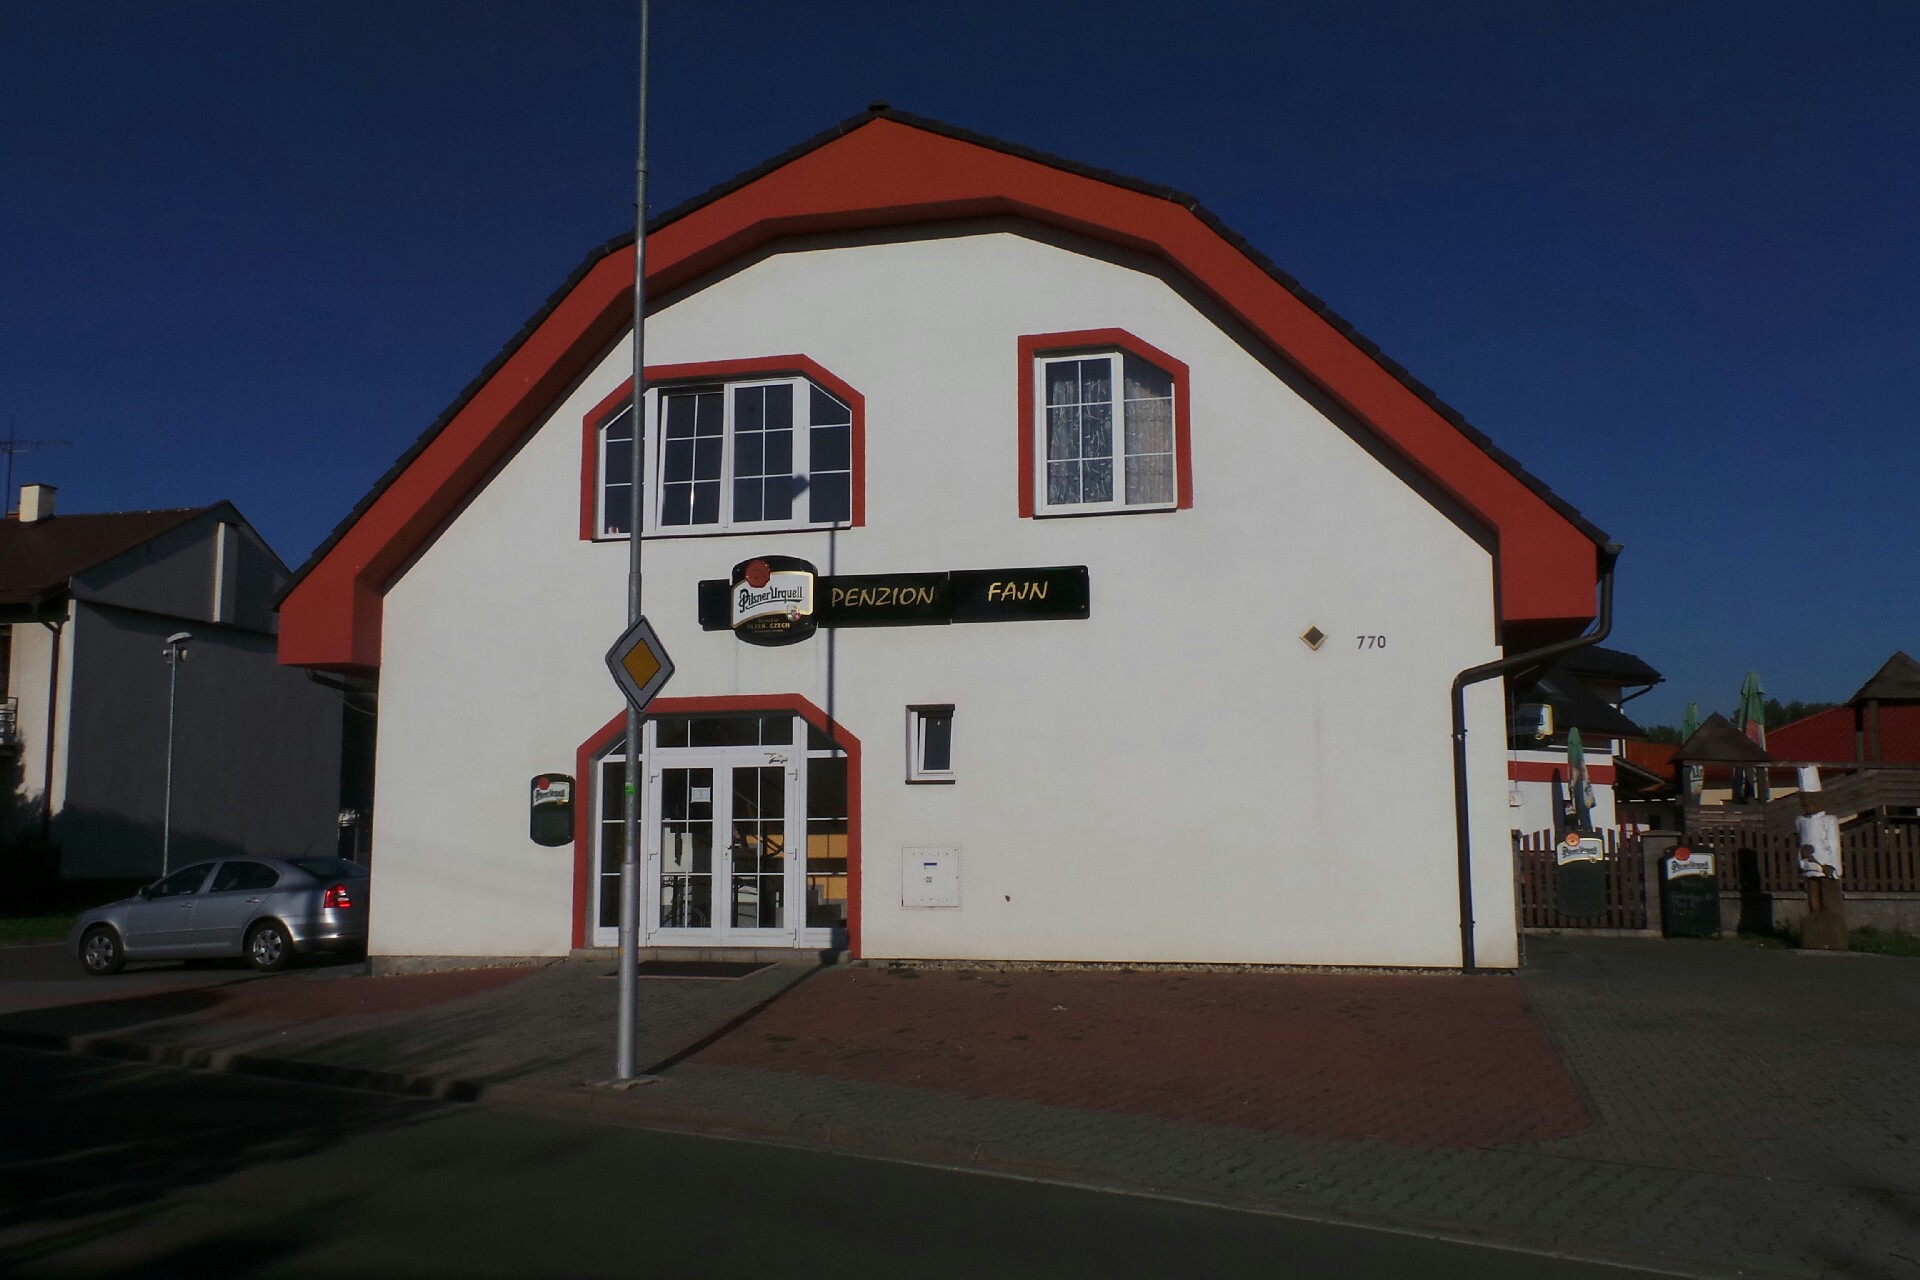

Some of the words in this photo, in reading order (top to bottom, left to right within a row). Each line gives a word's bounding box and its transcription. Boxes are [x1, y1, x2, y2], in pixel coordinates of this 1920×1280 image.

[738, 588, 770, 613] Pilsner
[769, 585, 802, 603] Urquell
[831, 585, 935, 608] PENZION
[987, 580, 1048, 602] FAJN
[1357, 635, 1386, 649] 770
